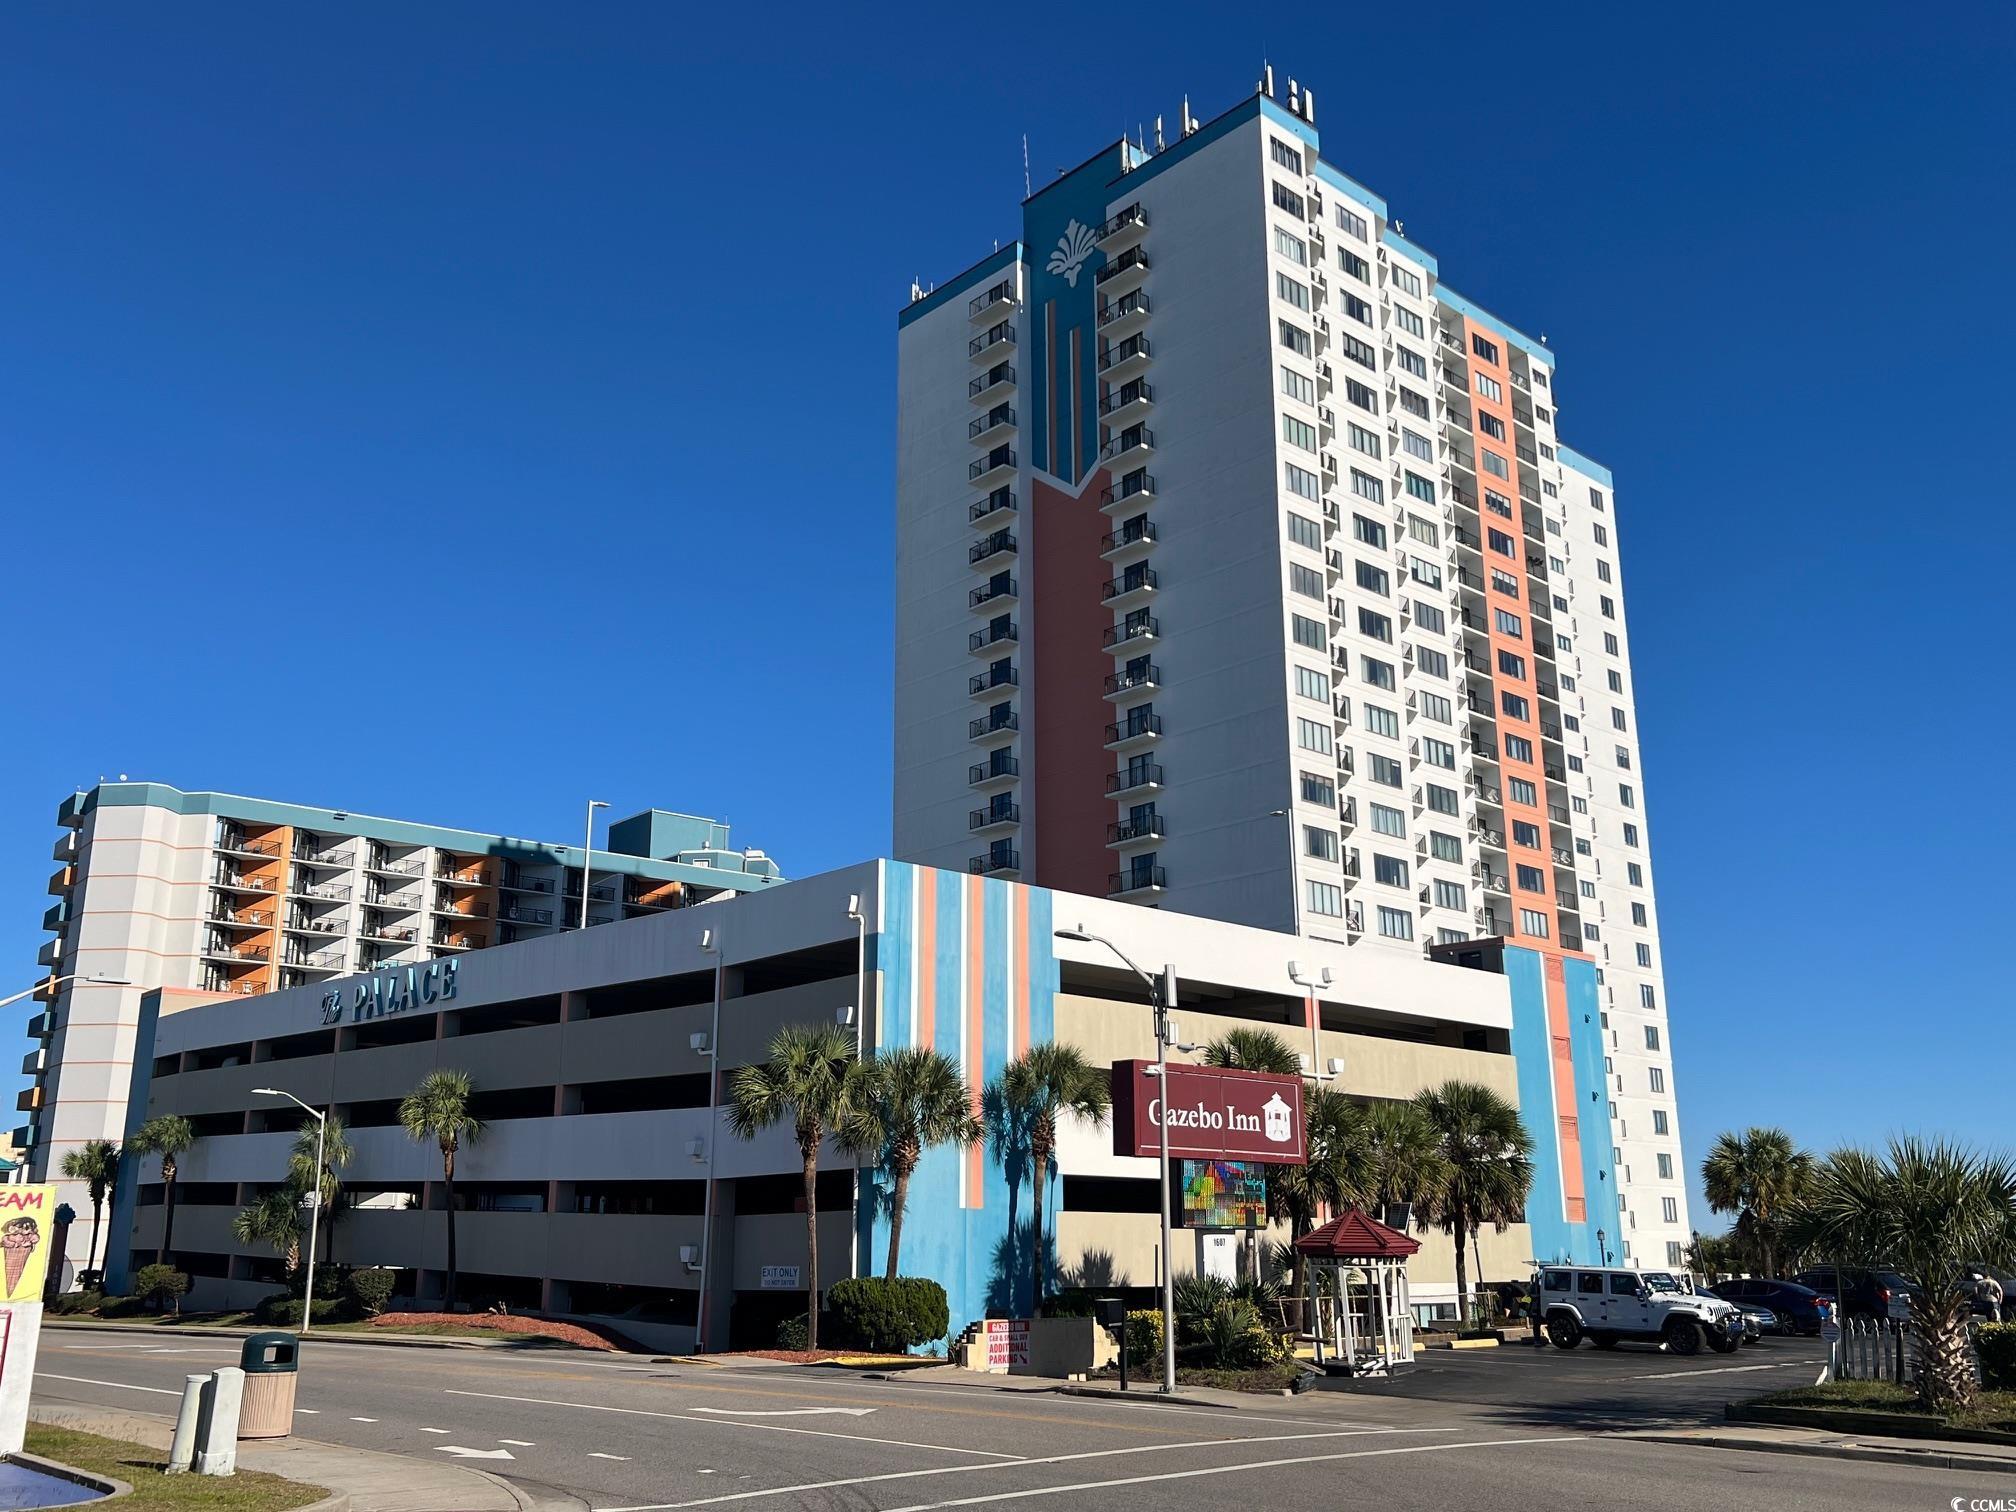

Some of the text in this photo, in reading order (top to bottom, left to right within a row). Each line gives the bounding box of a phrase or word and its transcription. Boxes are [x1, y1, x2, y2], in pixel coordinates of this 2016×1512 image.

[352, 958, 459, 1022] PALACE
[1148, 1098, 1261, 1132] Gazebo Inn
[762, 1267, 798, 1278] EXIT ONLY
[989, 1334, 999, 1342] CAR
[989, 1342, 1029, 1354] ADDITIONAL
[989, 1353, 1018, 1365] PARKING
